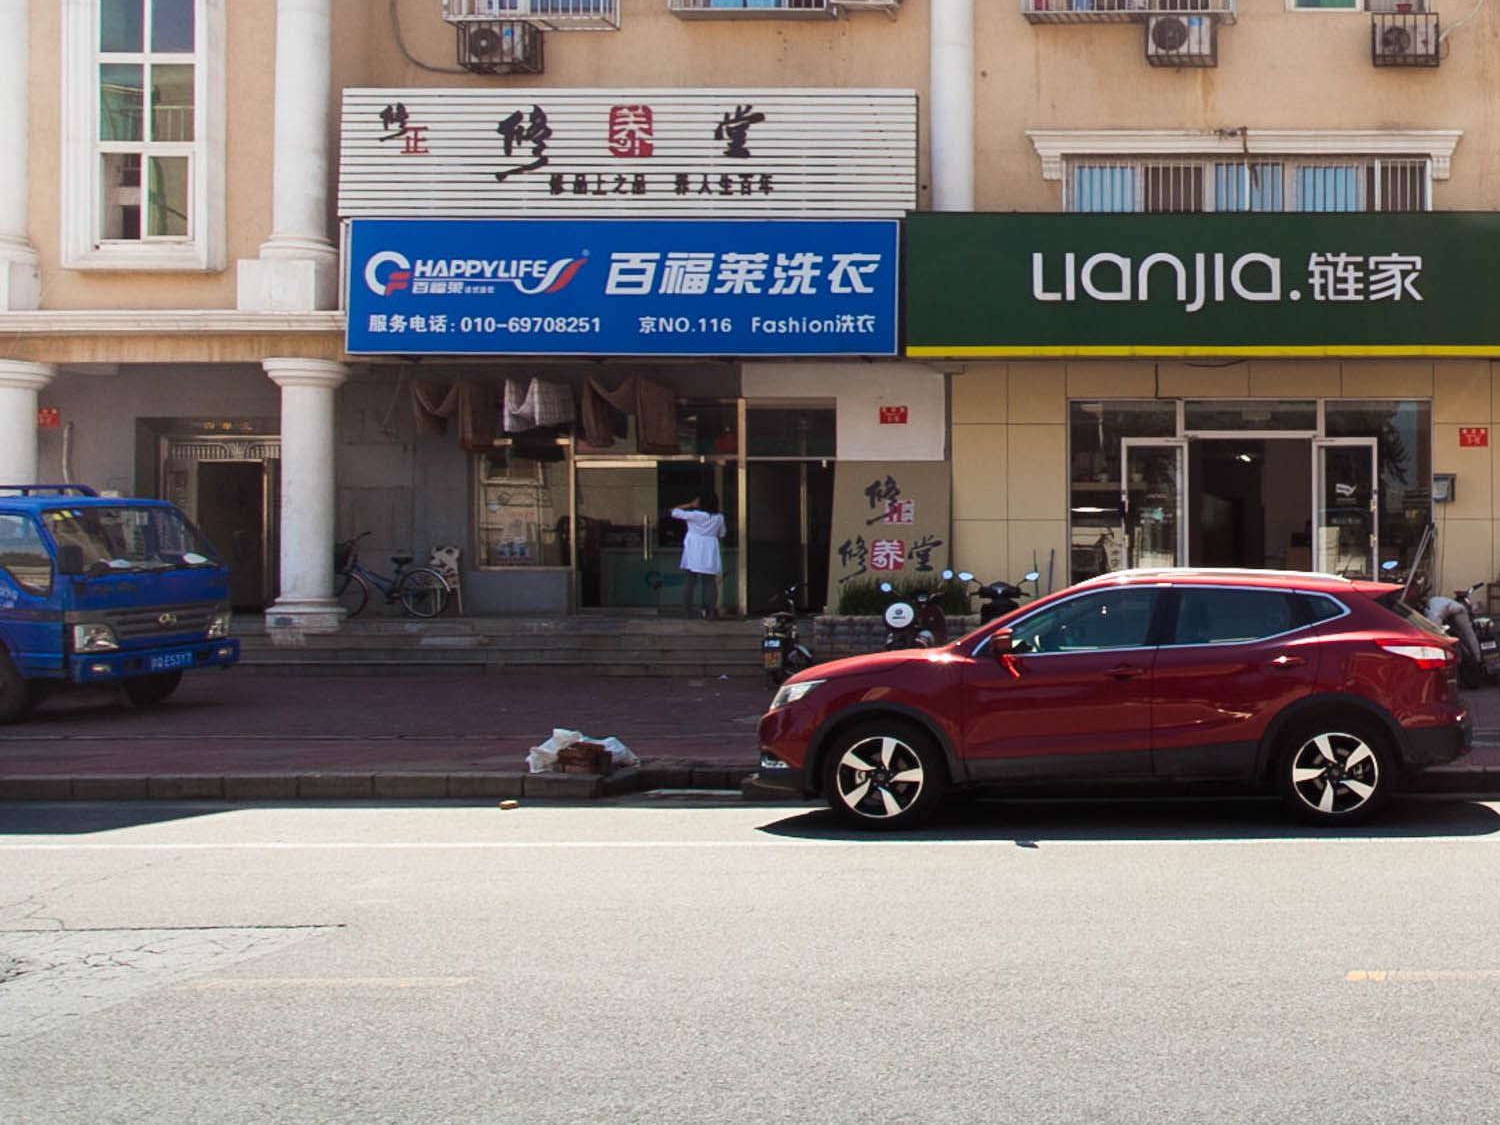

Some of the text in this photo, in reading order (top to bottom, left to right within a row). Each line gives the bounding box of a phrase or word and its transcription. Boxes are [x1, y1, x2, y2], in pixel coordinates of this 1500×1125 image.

[413, 259, 549, 278] HAPPYLIFE
[604, 252, 881, 295] 百福莱洗衣
[751, 314, 876, 334] Fashion洗衣
